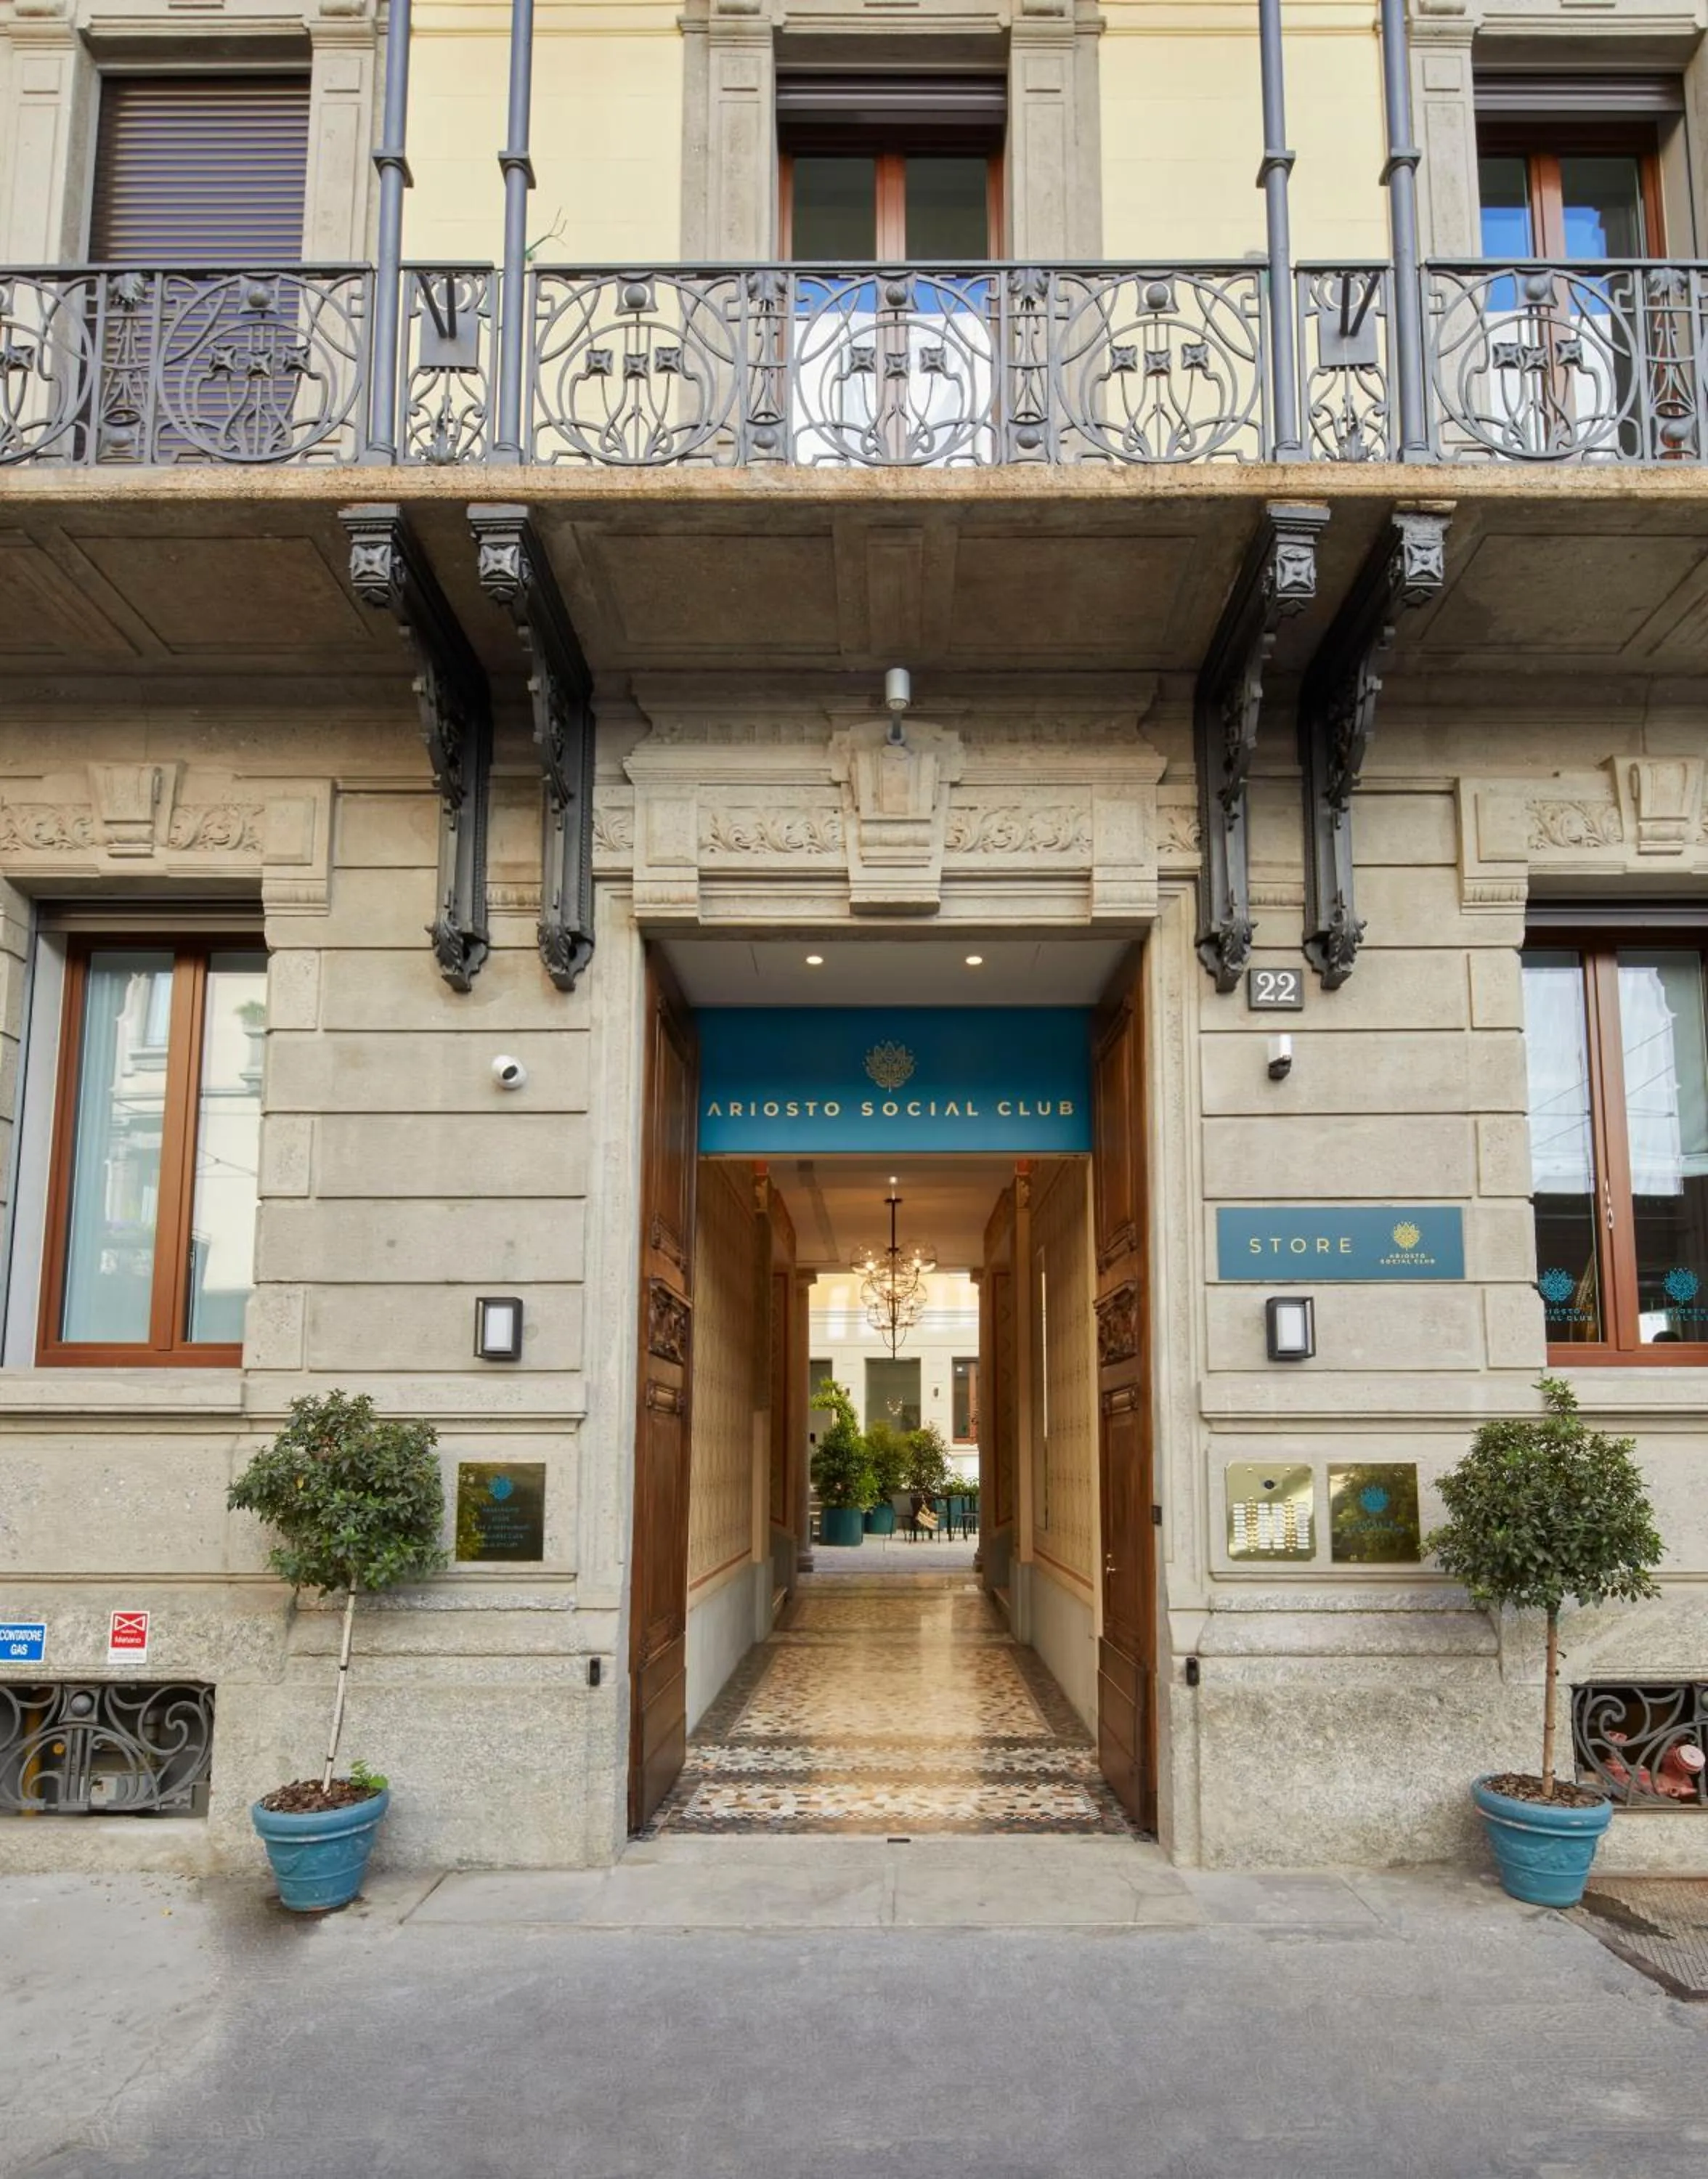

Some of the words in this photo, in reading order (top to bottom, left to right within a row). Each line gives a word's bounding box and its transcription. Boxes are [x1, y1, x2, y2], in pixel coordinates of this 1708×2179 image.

[1256, 973, 1296, 1002] 22
[707, 1102, 841, 1116] ARIOSTO
[861, 1101, 979, 1116] SOCIAL
[997, 1100, 1074, 1116] CLUB
[1249, 1238, 1352, 1254] STORE
[11, 1644, 28, 1655] GAS
